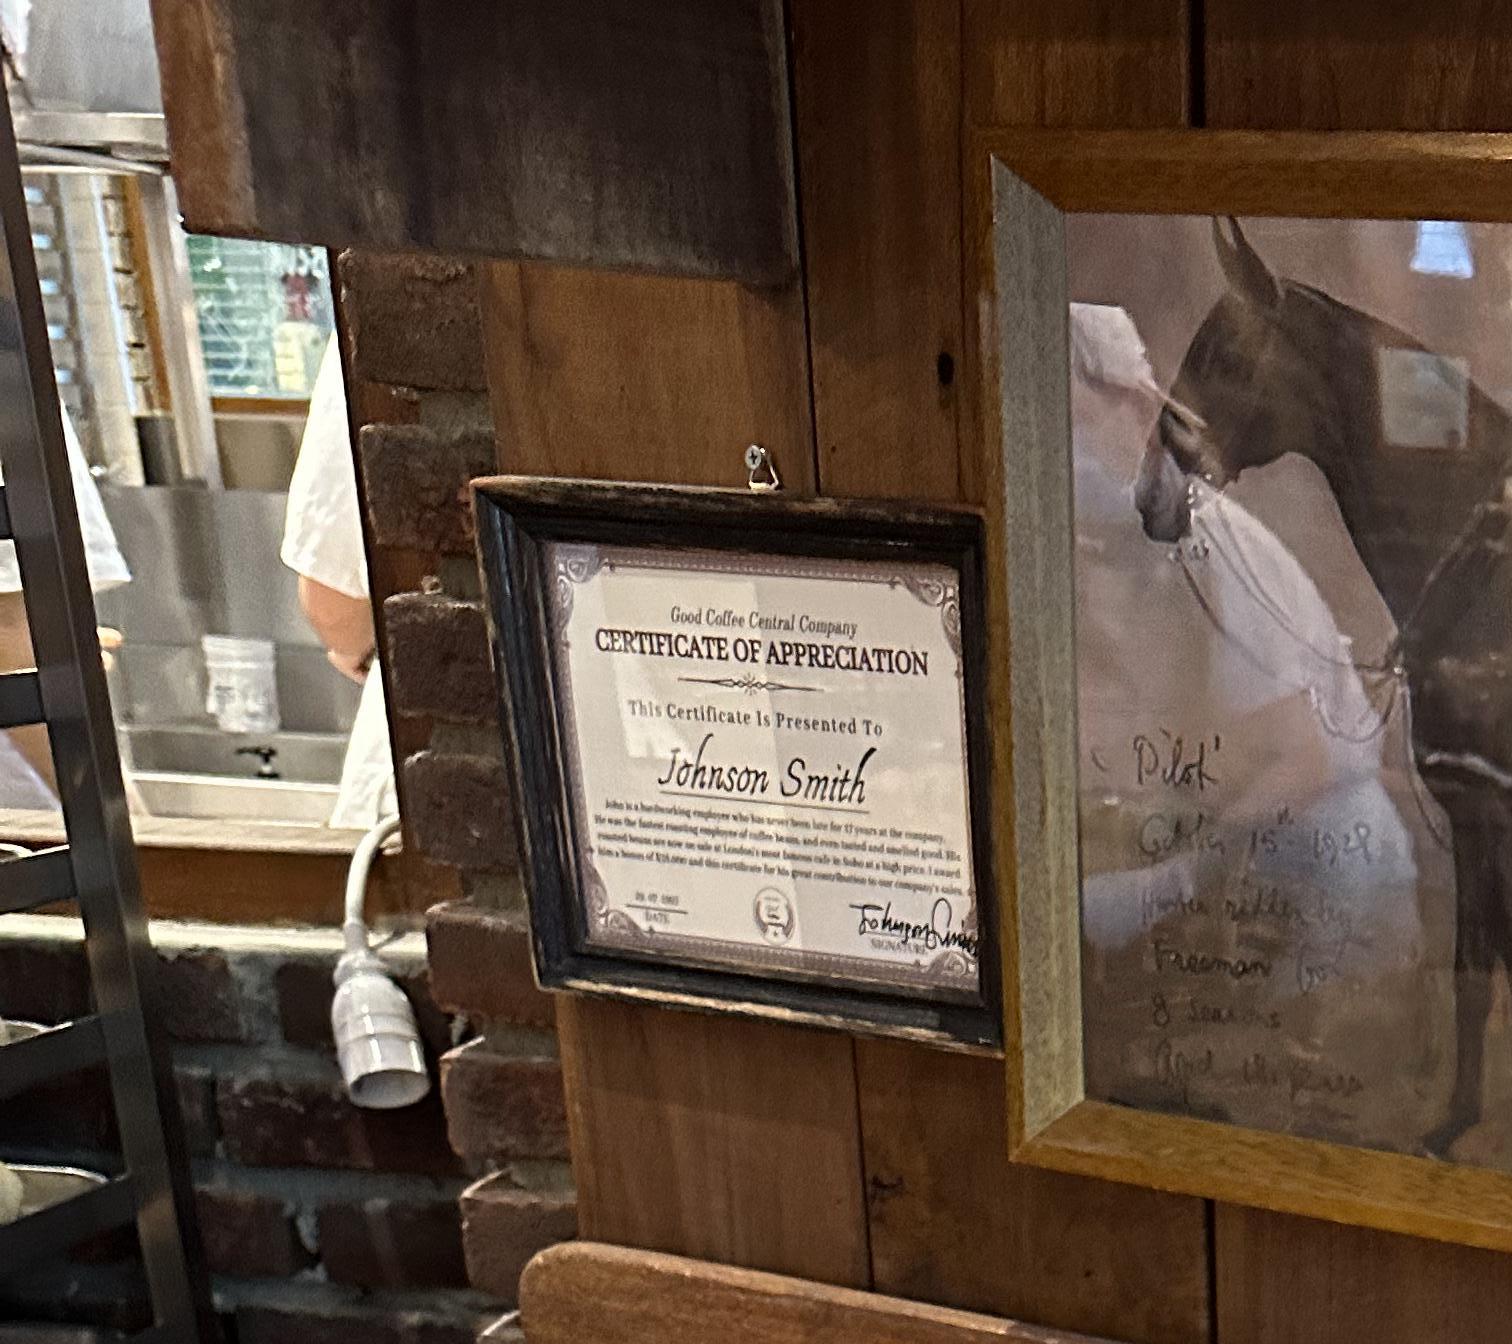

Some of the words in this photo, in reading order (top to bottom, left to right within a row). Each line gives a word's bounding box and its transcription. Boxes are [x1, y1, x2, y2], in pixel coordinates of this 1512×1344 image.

[671, 605, 702, 625] Good
[706, 608, 745, 627] Coffee
[750, 611, 795, 631] Central
[800, 615, 857, 639] Company
[595, 628, 729, 661] CERTIFICATE
[733, 637, 762, 664] OF
[766, 640, 928, 676] APPRECIATION
[628, 699, 662, 717] This
[666, 703, 751, 726] Certificate
[756, 710, 770, 727] Is
[776, 712, 856, 734] Presented
[862, 719, 883, 737] To
[658, 732, 769, 795] Johnson
[780, 747, 877, 804] Smith
